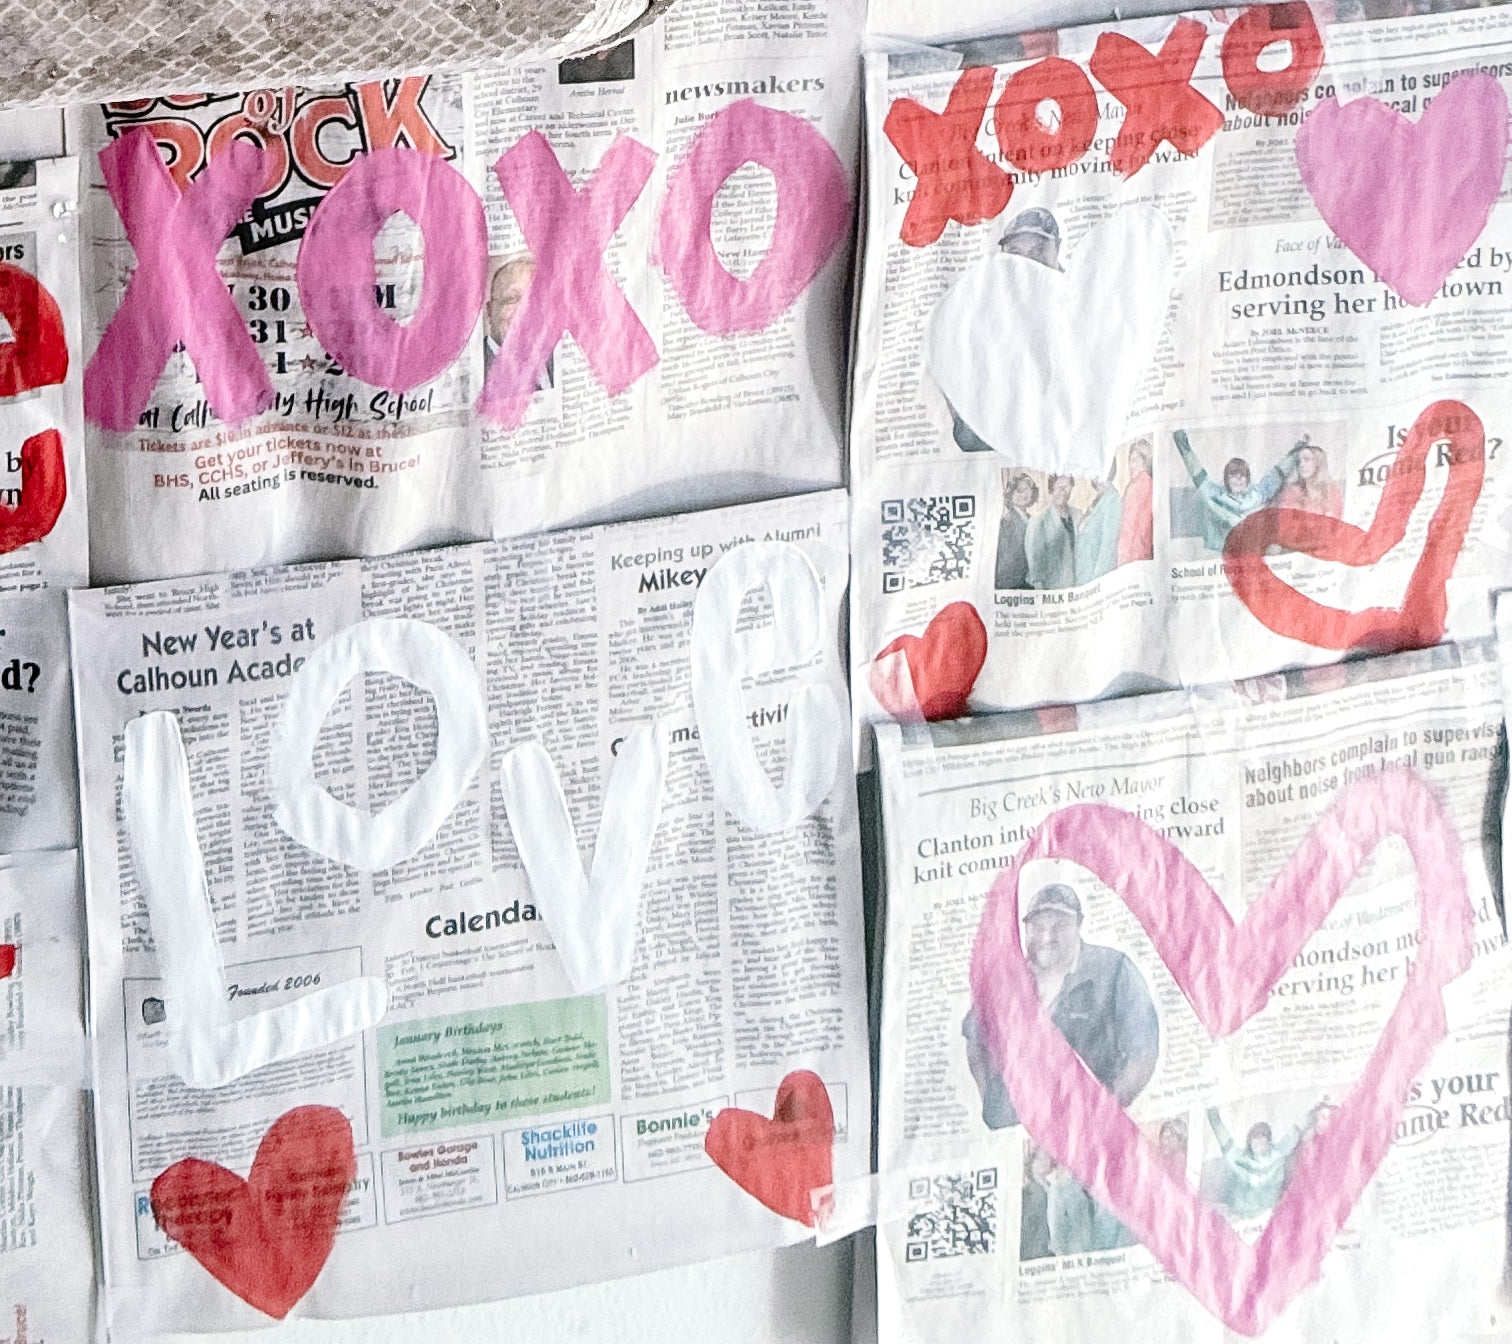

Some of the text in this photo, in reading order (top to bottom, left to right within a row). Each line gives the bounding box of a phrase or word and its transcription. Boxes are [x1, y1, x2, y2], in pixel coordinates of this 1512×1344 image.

[883, 0, 1326, 247] XOXO
[85, 98, 852, 434] XOXO
[1218, 258, 1365, 291] Edmondson
[1231, 292, 1376, 321] serving her
[142, 617, 315, 657] New Year's at
[116, 665, 217, 695] Calhoun
